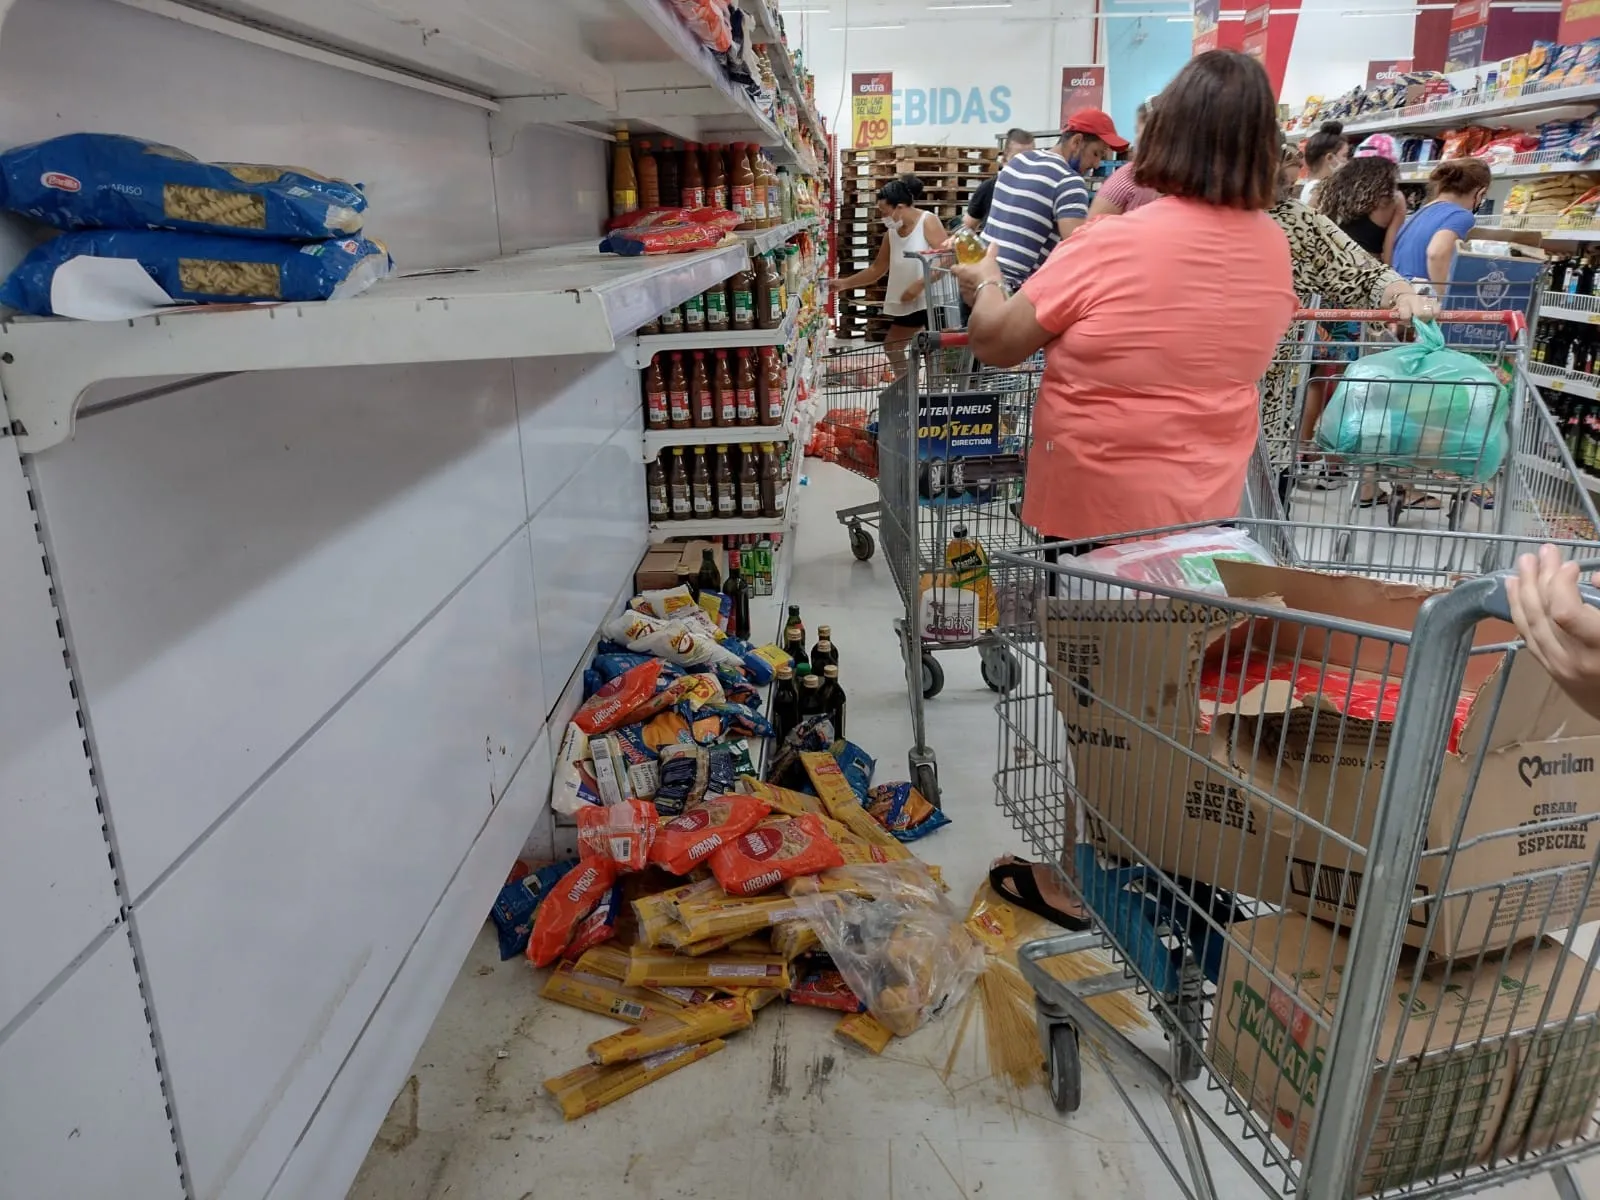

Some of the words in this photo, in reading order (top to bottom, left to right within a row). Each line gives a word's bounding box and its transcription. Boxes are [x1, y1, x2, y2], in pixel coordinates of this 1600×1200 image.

[860, 79, 885, 93] extra
[1071, 76, 1096, 87] extra
[891, 84, 1012, 126] EBIDAS
[1314, 310, 1336, 319] extra
[1350, 310, 1373, 319] extra
[955, 404, 992, 416] PNEUS
[918, 421, 993, 439] ODYEAR
[951, 438, 992, 447] DIRECTION
[591, 699, 622, 728] URBANO
[1518, 753, 1594, 788] Marilan
[1533, 801, 1578, 816] CREAM
[688, 833, 723, 861] URBANO
[1517, 834, 1586, 857] ESPECIAL
[567, 866, 599, 903] URBANO
[742, 869, 782, 893] URBANO
